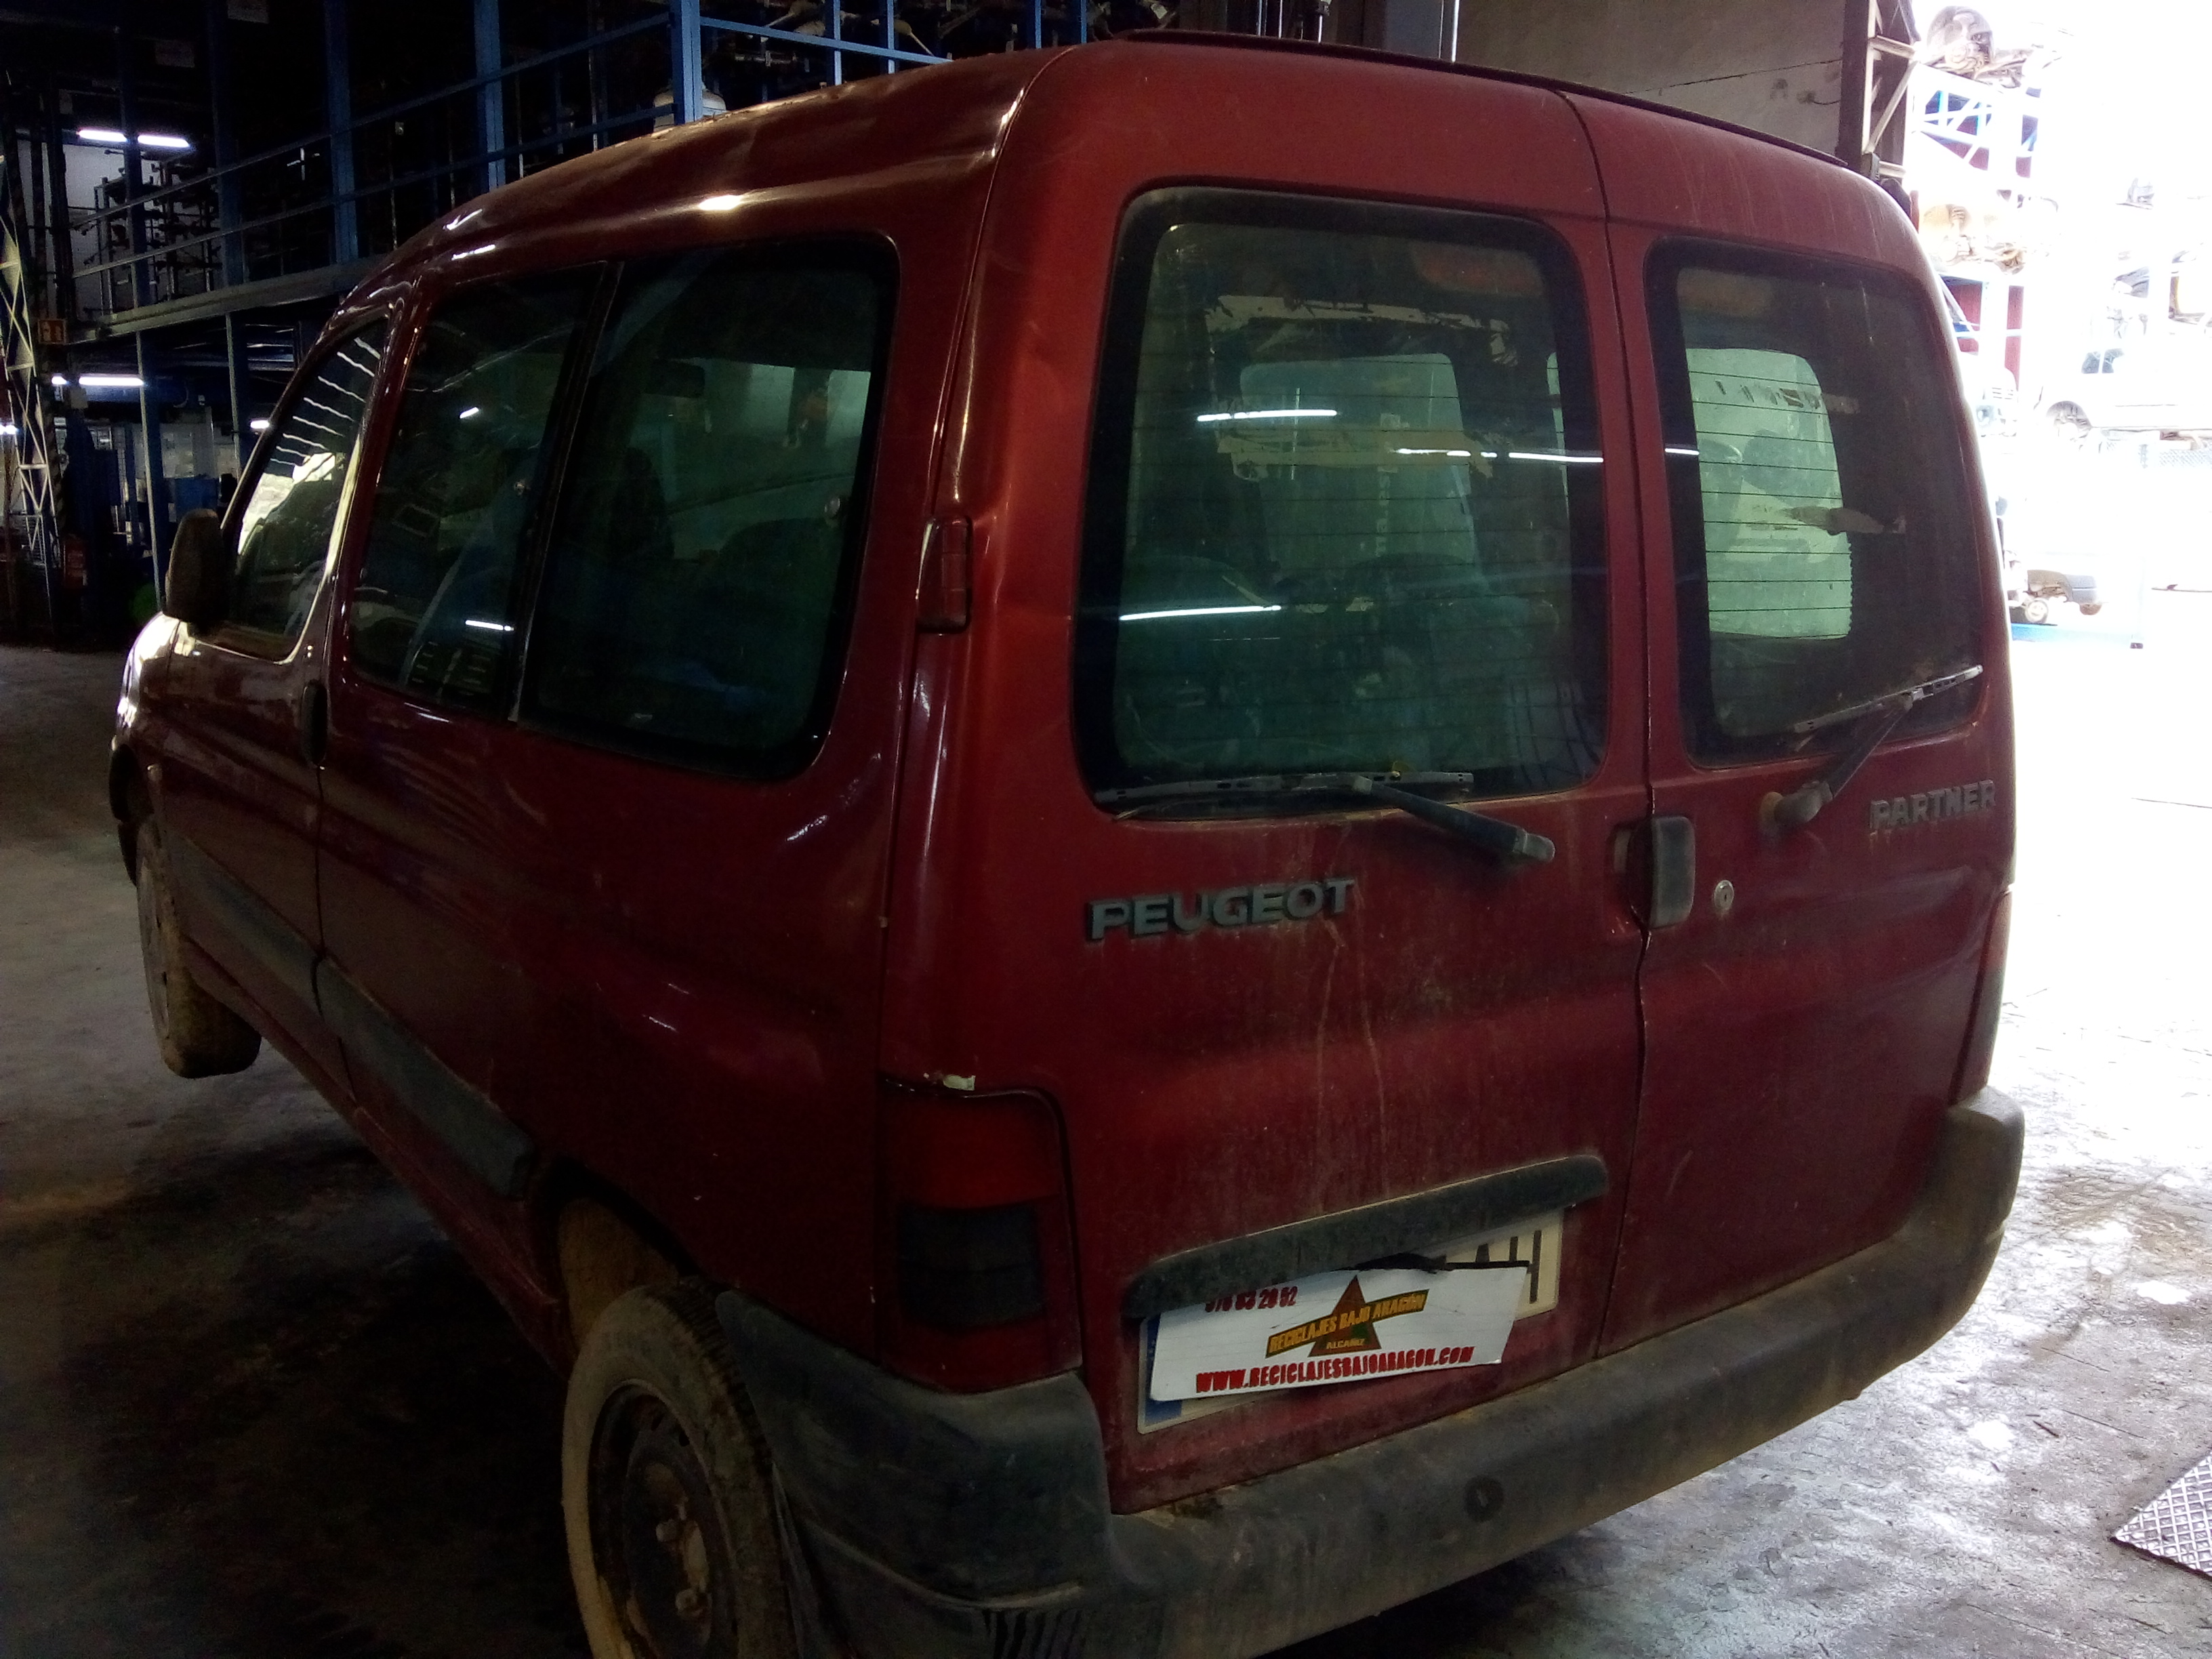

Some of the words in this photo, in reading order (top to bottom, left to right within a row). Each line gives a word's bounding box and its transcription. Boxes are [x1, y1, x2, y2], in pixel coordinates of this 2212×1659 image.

[1869, 779, 1996, 829] PARTNER
[1086, 878, 1355, 940] PEUGEOT
[1269, 1316, 1338, 1353] RECICLAJES
[1338, 1305, 1372, 1330] BAJO
[1195, 1346, 1475, 1393] WWW.RECICLAJESBAJOARAGON.COM
